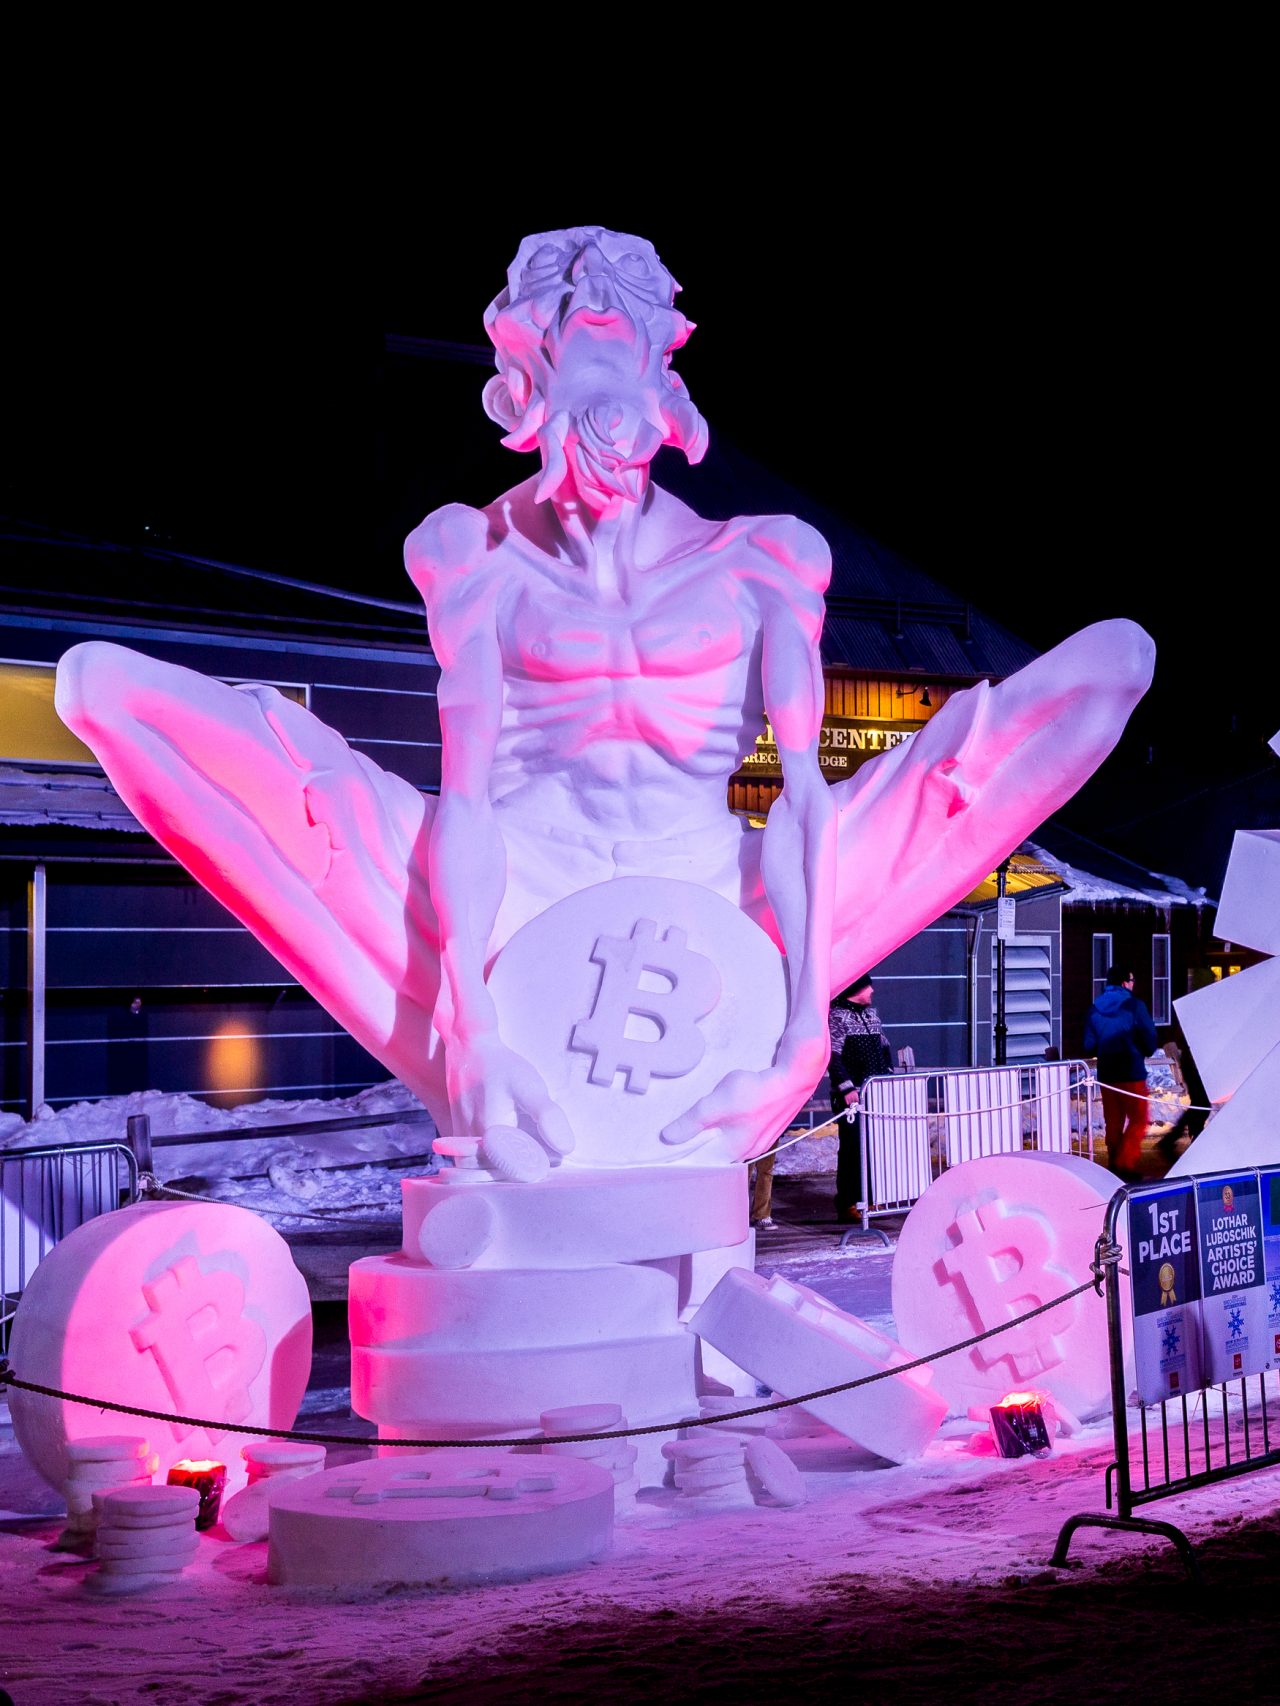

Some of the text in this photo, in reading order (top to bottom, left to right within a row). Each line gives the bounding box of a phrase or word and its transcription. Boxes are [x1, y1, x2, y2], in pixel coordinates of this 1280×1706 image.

[1148, 1202, 1179, 1236] 1ST
[1212, 1213, 1248, 1231] LOTHAR
[1206, 1226, 1256, 1246] LUBOSCHIK
[1138, 1231, 1192, 1263] PLACE
[1207, 1240, 1257, 1262] ARTISTS'
[1211, 1255, 1255, 1276] CHOICE
[1212, 1270, 1255, 1291] AWARD
